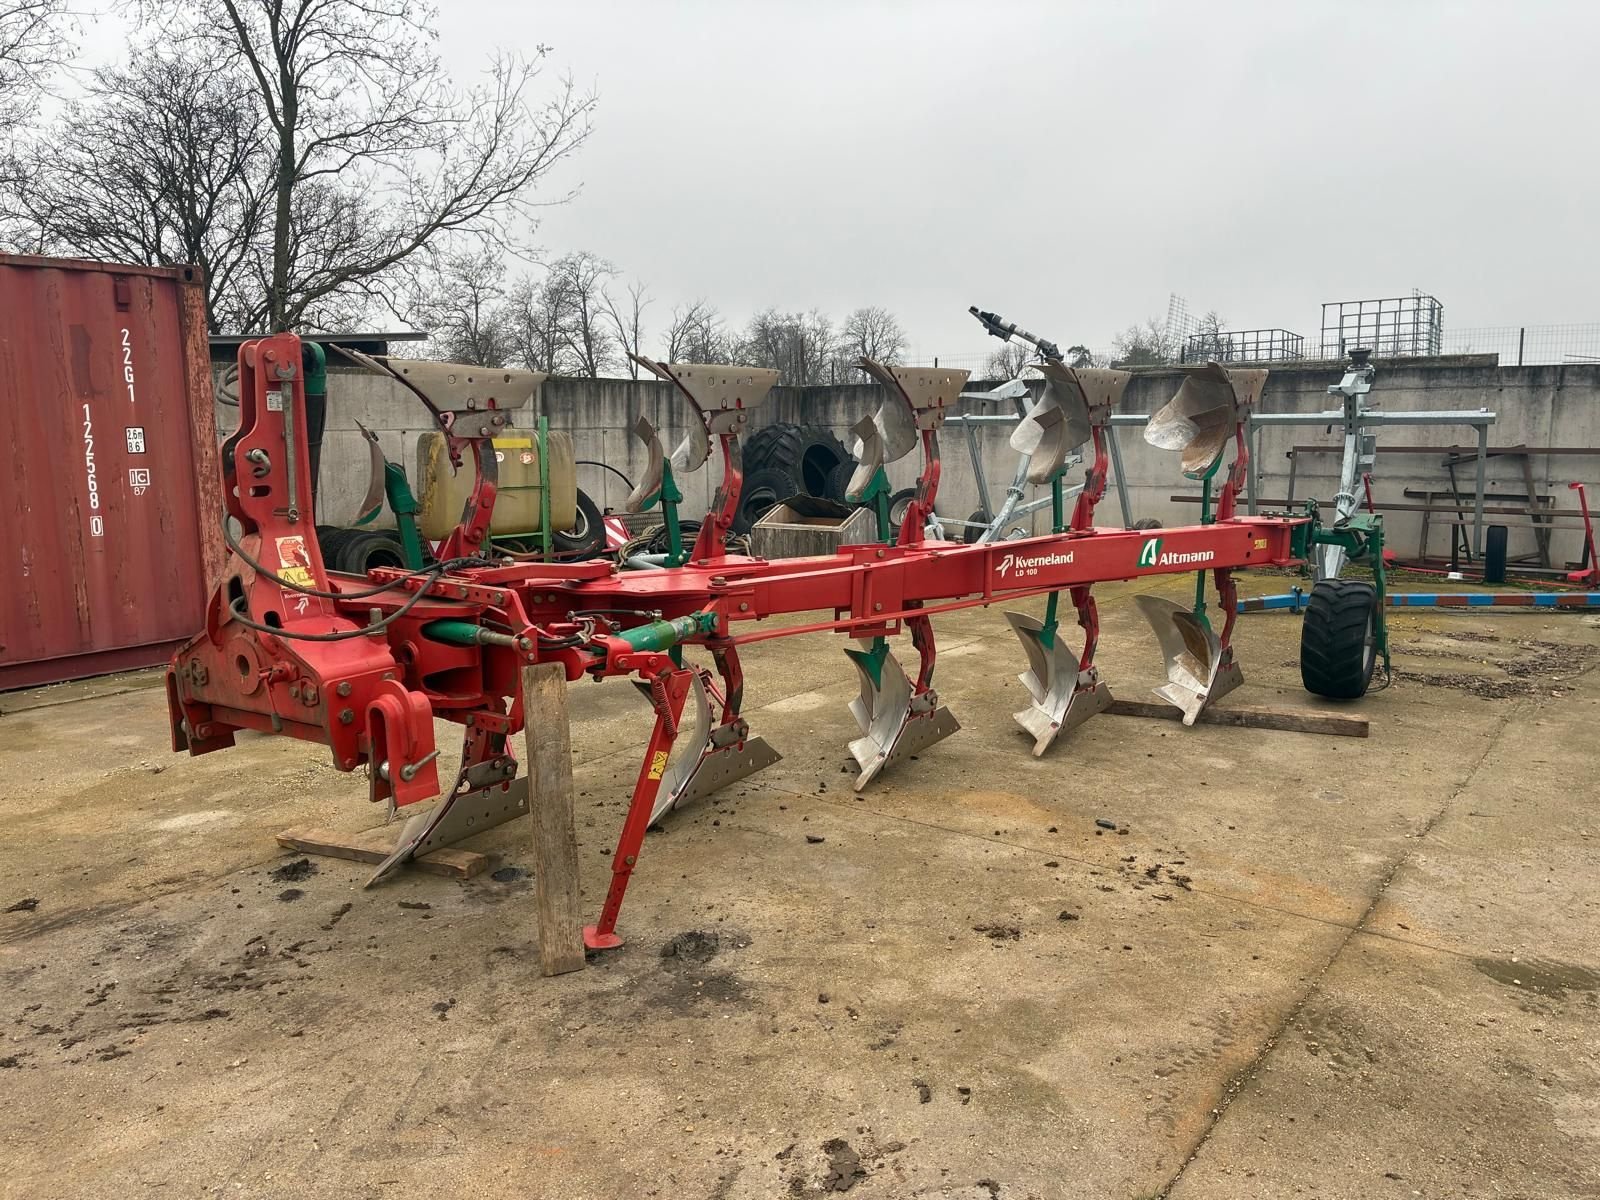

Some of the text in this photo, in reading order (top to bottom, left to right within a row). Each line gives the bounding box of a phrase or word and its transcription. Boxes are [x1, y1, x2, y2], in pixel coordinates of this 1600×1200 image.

[121, 328, 134, 402] 22G1
[82, 404, 98, 509] 122568
[134, 486, 146, 496] 87
[1015, 551, 1074, 569] Kverneland
[1159, 550, 1214, 566] Altmann
[1015, 568, 1038, 577] LD 100
